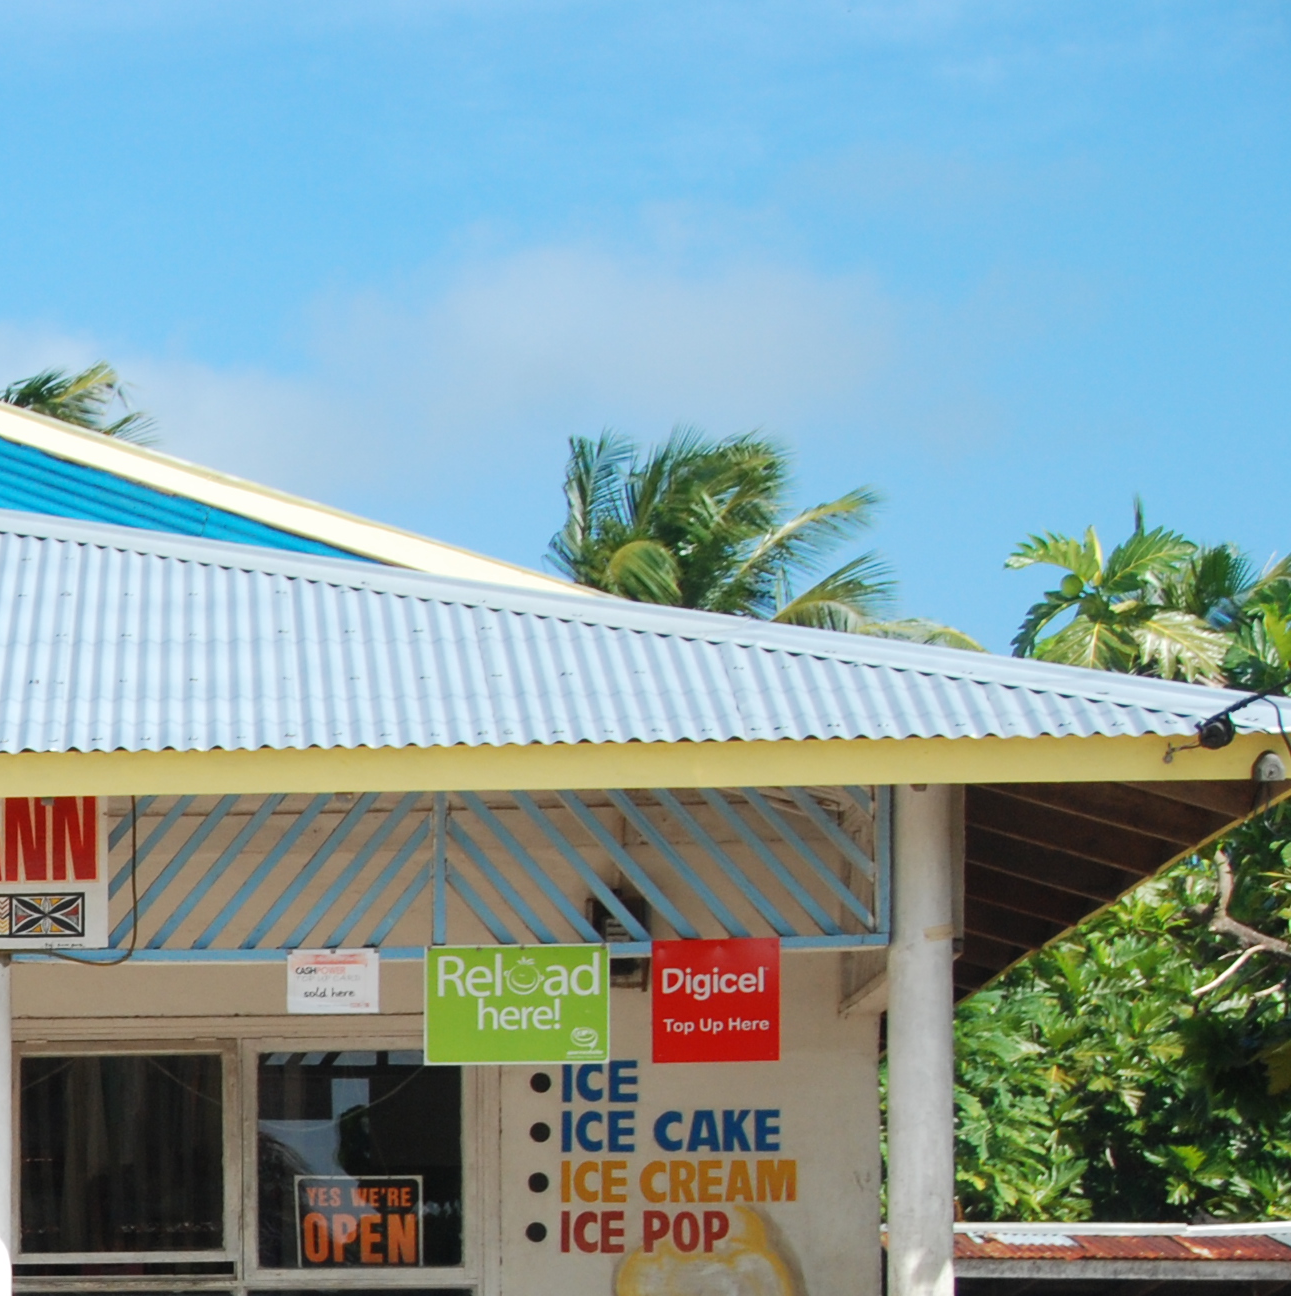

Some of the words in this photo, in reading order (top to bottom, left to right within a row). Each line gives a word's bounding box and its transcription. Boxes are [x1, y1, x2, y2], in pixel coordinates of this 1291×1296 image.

[304, 987, 327, 998] sold
[331, 987, 356, 998] here
[662, 966, 765, 1001] Digicel
[478, 1000, 561, 1031] here!
[663, 1018, 695, 1035] Top
[699, 1017, 724, 1034] Up
[728, 1017, 770, 1031] Here
[561, 1060, 639, 1103] ICE
[561, 1110, 636, 1153] ICE
[653, 1109, 781, 1152] CAKE
[306, 1187, 343, 1209] YES
[349, 1187, 412, 1208] WE'RE
[560, 1161, 629, 1203] ICE
[639, 1159, 797, 1203] CREAM
[303, 1213, 417, 1264] OPEN
[560, 1210, 625, 1254] ICE
[642, 1210, 730, 1254] POP
